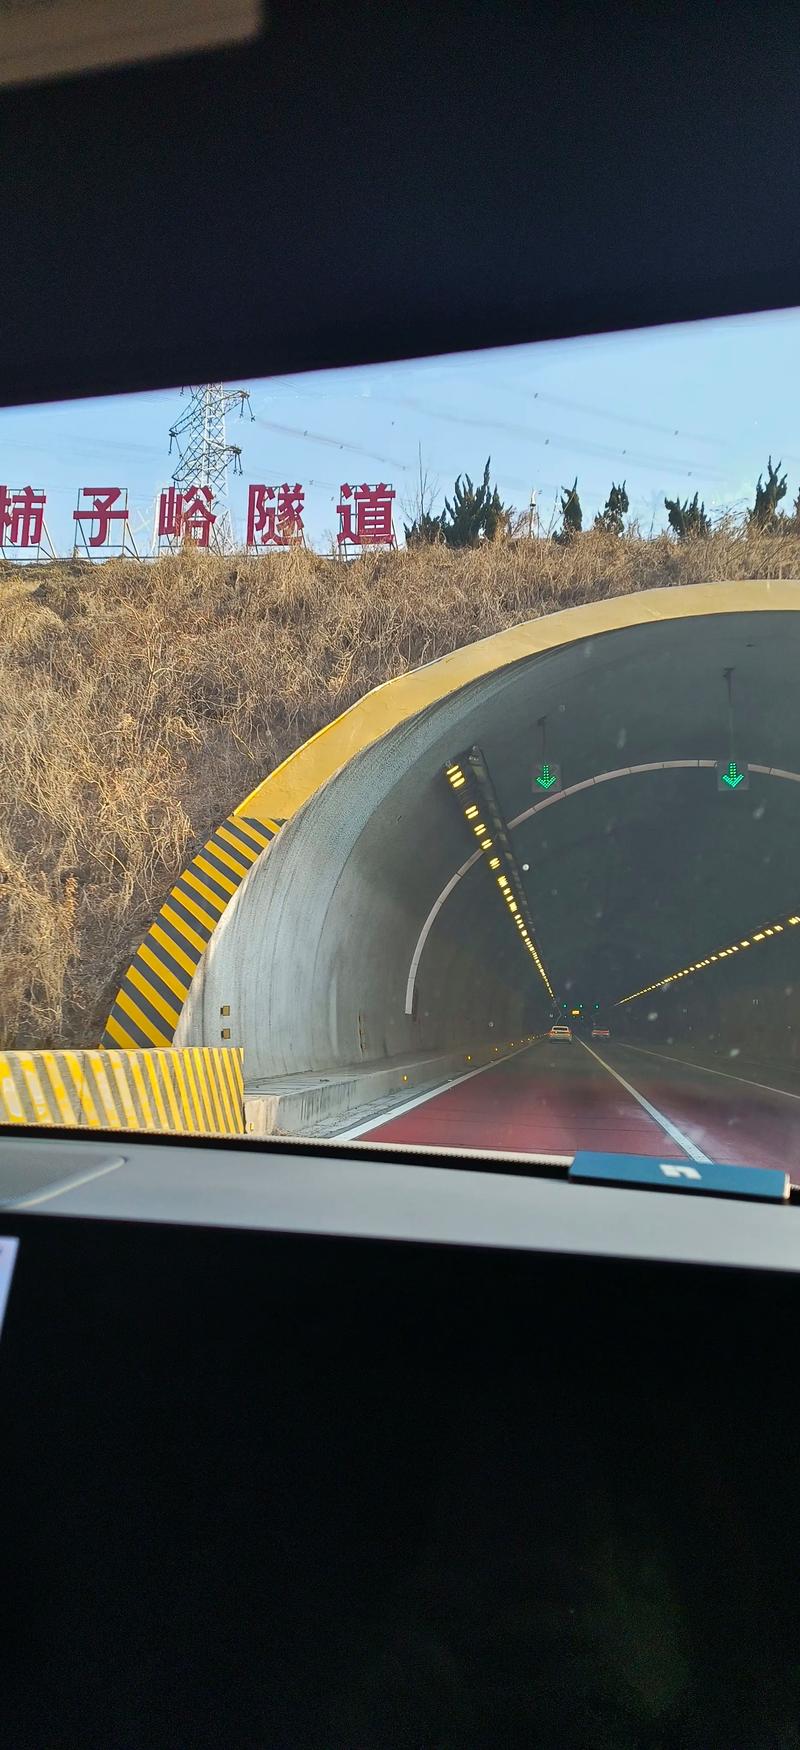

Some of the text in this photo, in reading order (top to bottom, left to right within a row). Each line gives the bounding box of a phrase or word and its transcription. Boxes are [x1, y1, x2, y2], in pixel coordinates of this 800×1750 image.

[0, 483, 396, 547] 柿子峪隧道
